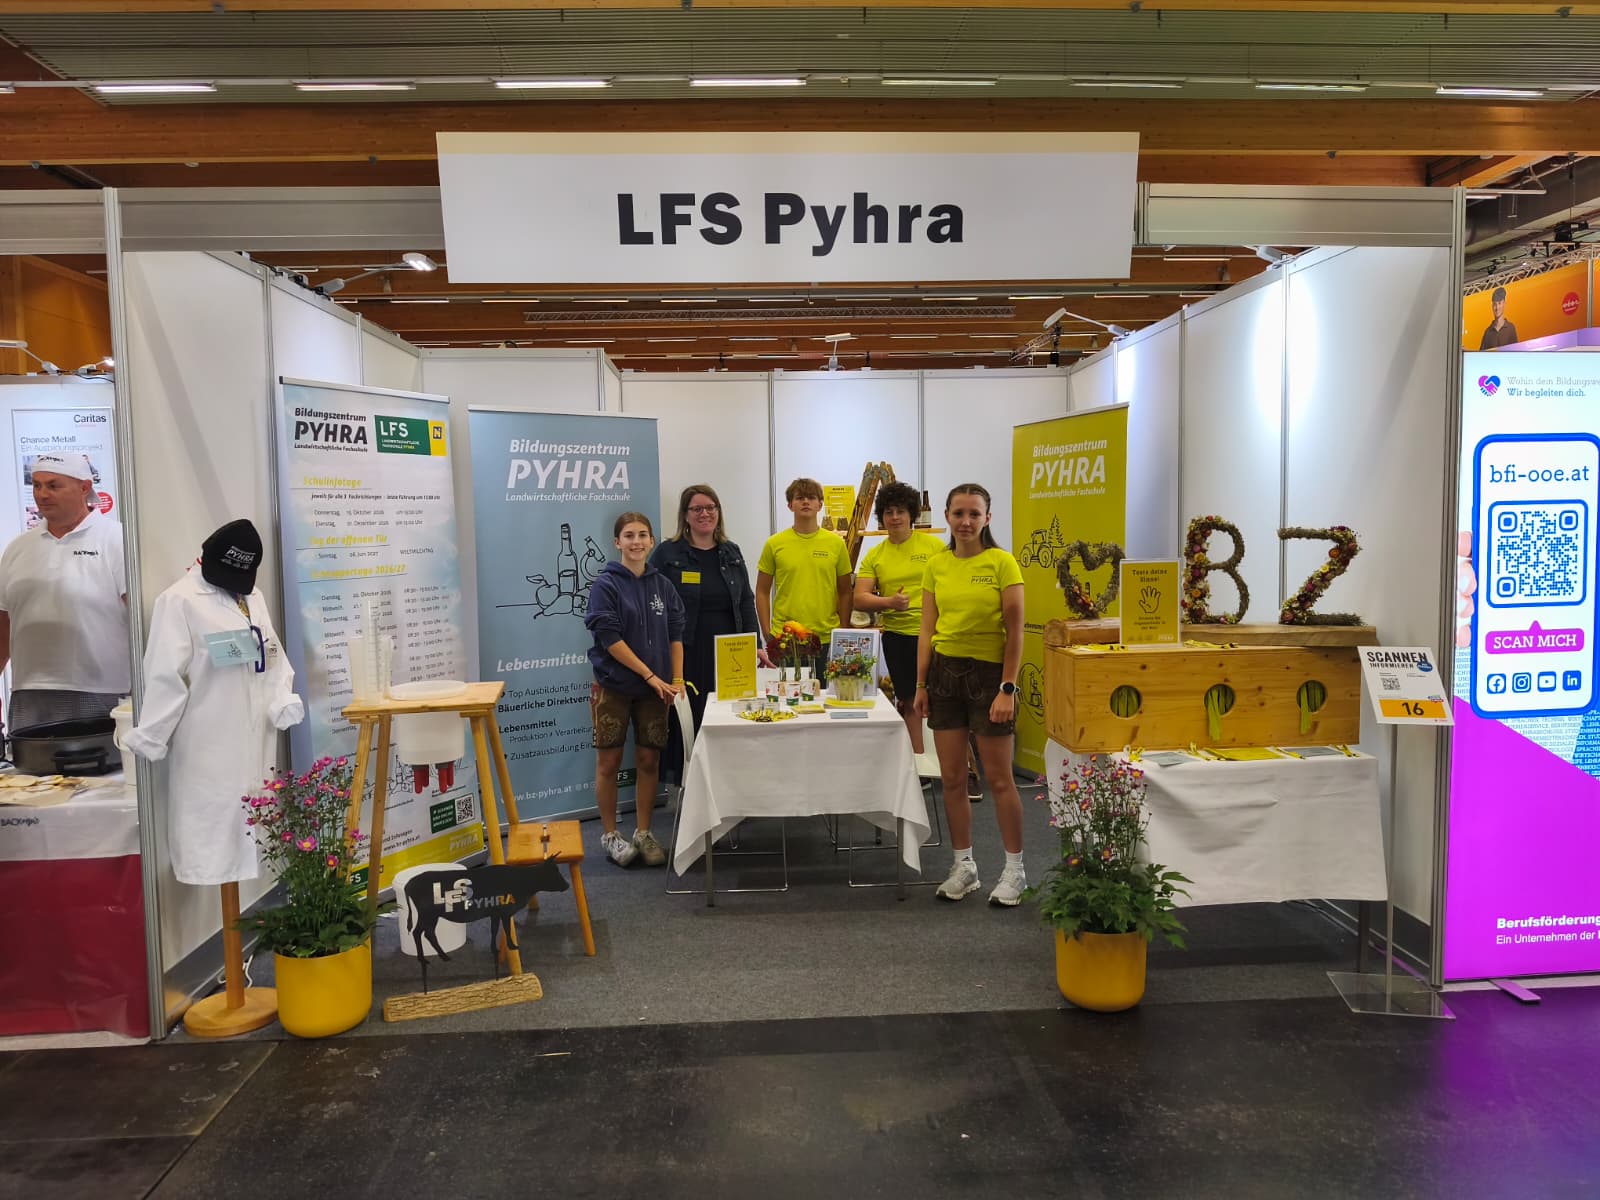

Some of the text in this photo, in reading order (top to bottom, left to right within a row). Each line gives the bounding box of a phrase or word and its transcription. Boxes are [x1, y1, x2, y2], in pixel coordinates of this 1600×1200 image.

[618, 192, 964, 256] LFS Pyhra
[1507, 376, 1536, 385] Wohin
[1540, 377, 1554, 385] dein
[1507, 387, 1586, 399] Wir begleiten dich.
[73, 414, 107, 423] Caritas
[294, 407, 366, 422] Bildungszentrum
[294, 421, 368, 445] PYHRA
[379, 420, 409, 438] LFS
[20, 435, 76, 444] Chance Metall
[294, 443, 342, 452] Landwirtschaftliche
[509, 439, 630, 457] Bildungszentrum
[1033, 439, 1107, 458] Bildungszentrum
[506, 459, 630, 490] PYHRA
[1030, 455, 1106, 489] PYHRA
[1489, 464, 1590, 483] bfi-ooe.at
[303, 476, 362, 489] Schulinfotage
[505, 492, 631, 503] Landwirtschaftliche Fachschule
[1029, 487, 1106, 499] Landwirtschaftliche Fachschule
[226, 549, 255, 562] PYHRA
[1493, 633, 1577, 650] SCAN MICH
[496, 651, 588, 673] Lebensmittel
[1366, 651, 1429, 663] SCANNEN
[508, 690, 523, 700] Top
[524, 682, 569, 697] Ausbildung
[570, 681, 581, 690] für
[498, 700, 545, 713] Bäuerliche
[1401, 702, 1425, 716] 16
[499, 718, 557, 734] Lebensmittel
[509, 731, 549, 744] Produktion
[510, 744, 580, 761] Zusatzausbildung
[617, 772, 628, 781] FS
[501, 785, 572, 804] w.bz-pyhra.at
[350, 873, 362, 883] FS
[432, 878, 474, 912] LFS
[464, 893, 516, 911] PYHRA
[1497, 914, 1600, 929] Berufsförderung
[1496, 930, 1596, 945] Ein Unternehmen der
